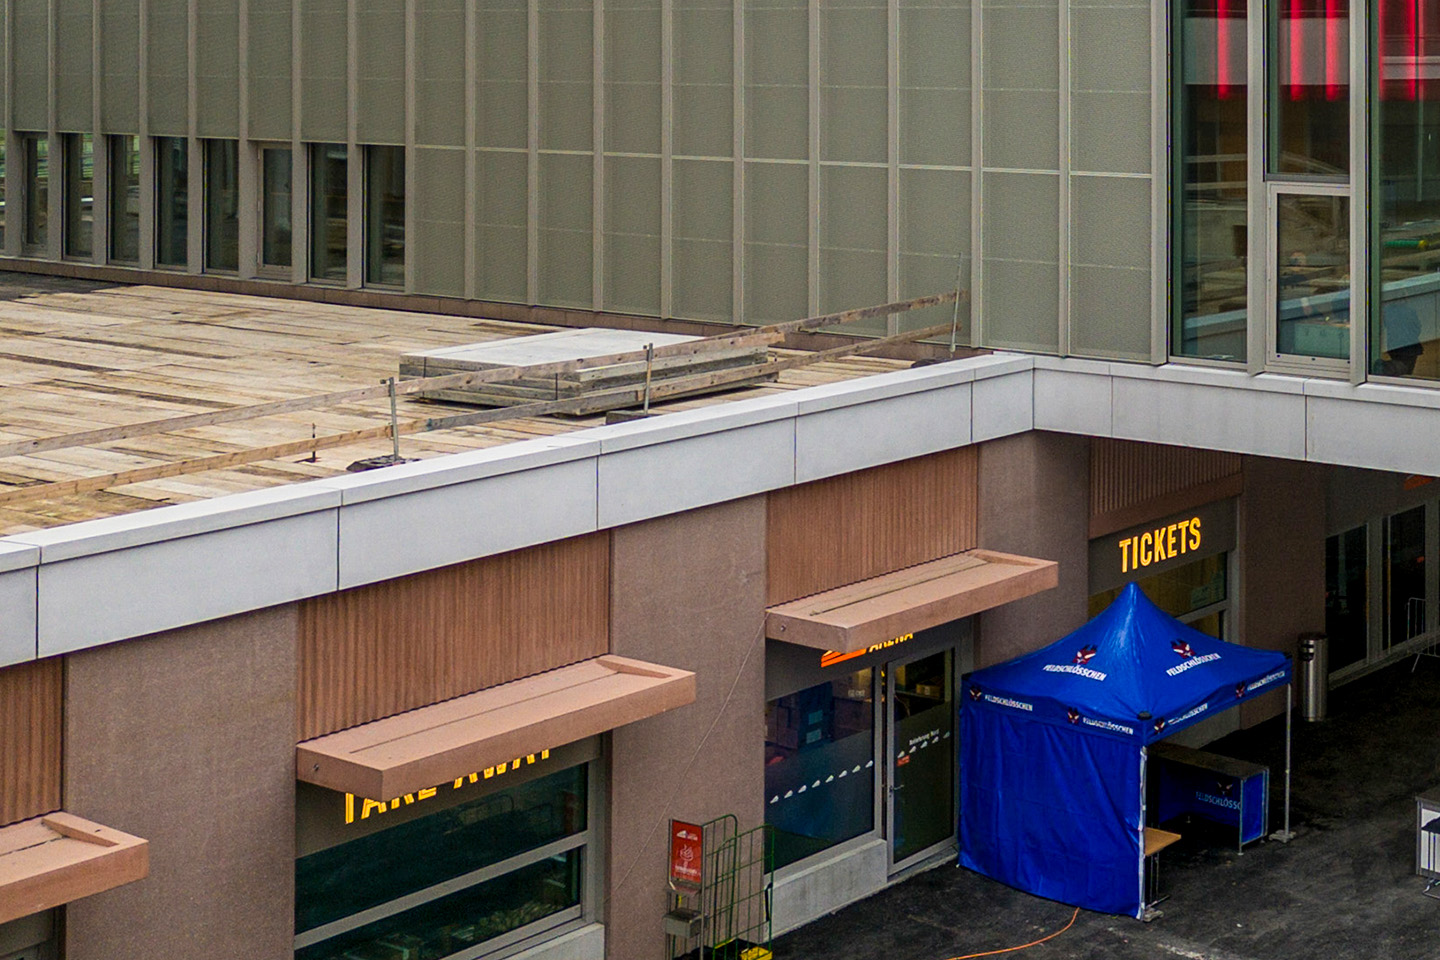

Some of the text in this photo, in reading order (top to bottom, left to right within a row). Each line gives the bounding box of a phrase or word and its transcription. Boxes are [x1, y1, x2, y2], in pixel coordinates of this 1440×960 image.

[1118, 517, 1201, 573] TICKETS
[1042, 663, 1107, 682] FELDSCHLÖSSCHEN
[1166, 652, 1222, 677] FELDSCHLÖSSCHEN
[1195, 791, 1241, 811] FELDSCHLÖSSC
